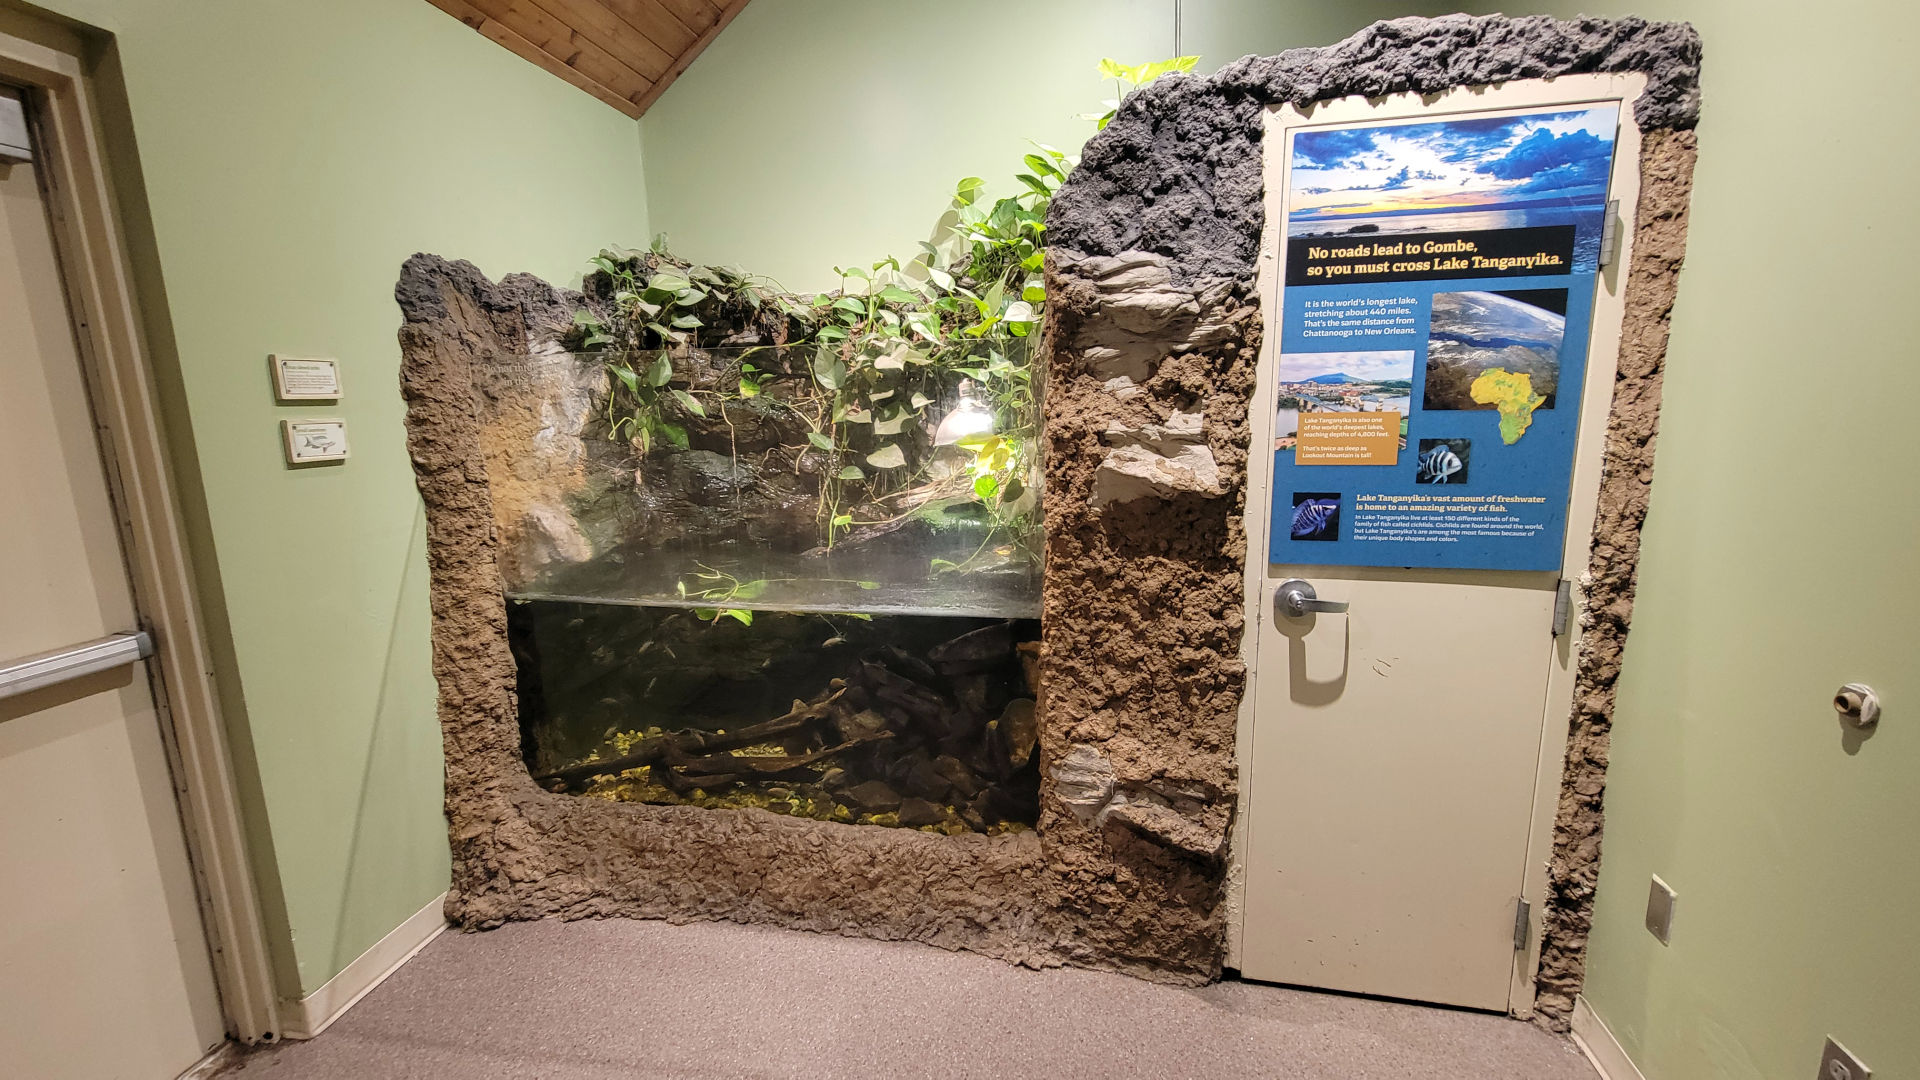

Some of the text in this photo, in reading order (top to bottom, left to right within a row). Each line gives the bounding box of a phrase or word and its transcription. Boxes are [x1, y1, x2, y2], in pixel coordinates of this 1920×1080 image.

[1308, 239, 1478, 258] No roads lead to Gombe,
[1307, 252, 1563, 279] so you must cross Lake Tanganyika.
[1336, 298, 1365, 306] world's
[1366, 298, 1396, 307] longest
[1398, 297, 1418, 305] lake,
[1304, 306, 1411, 318] stretching about 440 miles.
[1304, 318, 1326, 327] That's
[1303, 328, 1353, 337] Chattanooga
[1383, 326, 1416, 334] Orleans.
[1378, 494, 1430, 503] Tanganyika's
[1410, 504, 1445, 513] amazing
[1446, 504, 1477, 513] variety
